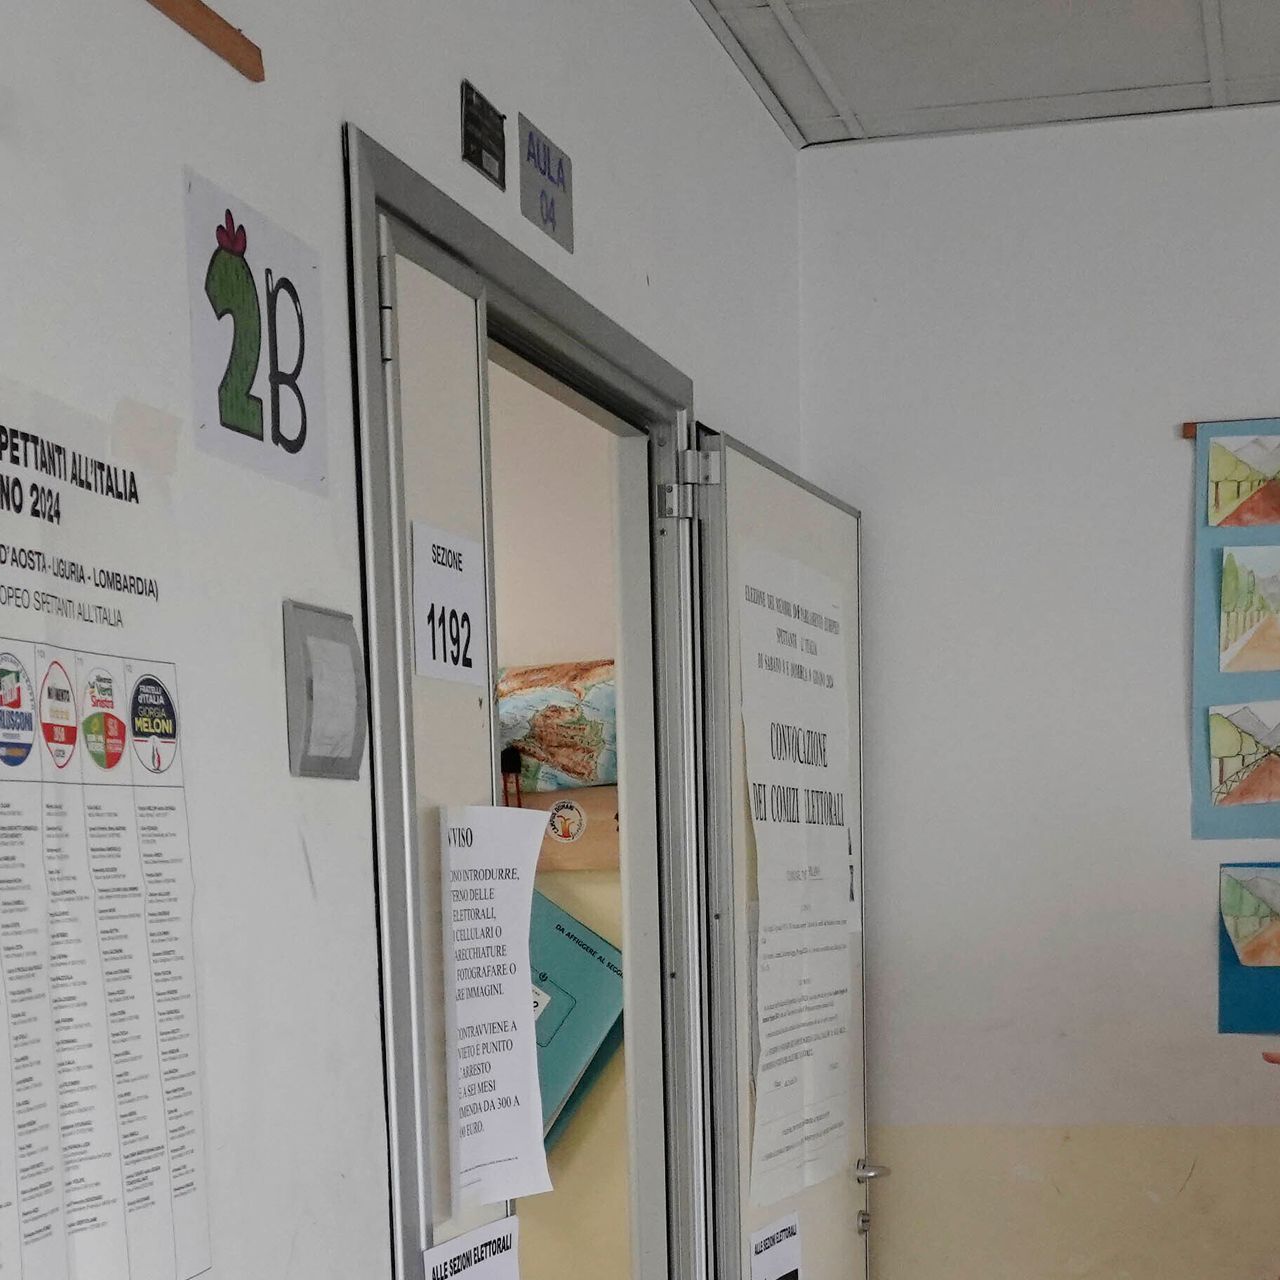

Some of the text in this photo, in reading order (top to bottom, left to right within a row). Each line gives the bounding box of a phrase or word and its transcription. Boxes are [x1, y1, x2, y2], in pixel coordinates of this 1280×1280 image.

[526, 131, 566, 193] AULA
[204, 246, 307, 454] 2B
[70, 451, 139, 503] ALL'ITALIA
[30, 483, 61, 525] 2024
[431, 543, 463, 572] SEZIONE
[0, 543, 47, 574] D'AOSTA
[52, 556, 86, 584] LIGURIA
[93, 567, 158, 602] LOMBARDIA)
[33, 591, 75, 619] SPETTANTI
[427, 603, 472, 669] 1192
[134, 717, 173, 734] MELONI
[771, 722, 827, 767] CONVOCAZIONE
[753, 782, 767, 821] DEI
[771, 784, 800, 823] COMIZI
[447, 827, 473, 848] VVISO
[463, 867, 520, 881] INTRODURRE,
[470, 887, 495, 901] DELLE
[456, 926, 493, 942] CELLULARI
[495, 925, 502, 938] O
[565, 931, 598, 957] AFFIGGERE
[457, 962, 517, 981] FOTOGRAFARE O
[511, 1020, 517, 1032] A
[482, 1039, 513, 1055] PUNITO
[478, 1079, 496, 1095] MESI
[483, 1099, 496, 1112] DA
[498, 1096, 512, 1109] 300
[513, 1095, 520, 1107] A
[449, 1249, 472, 1277] SEZIONI
[473, 1233, 512, 1265] ELETTORALI
